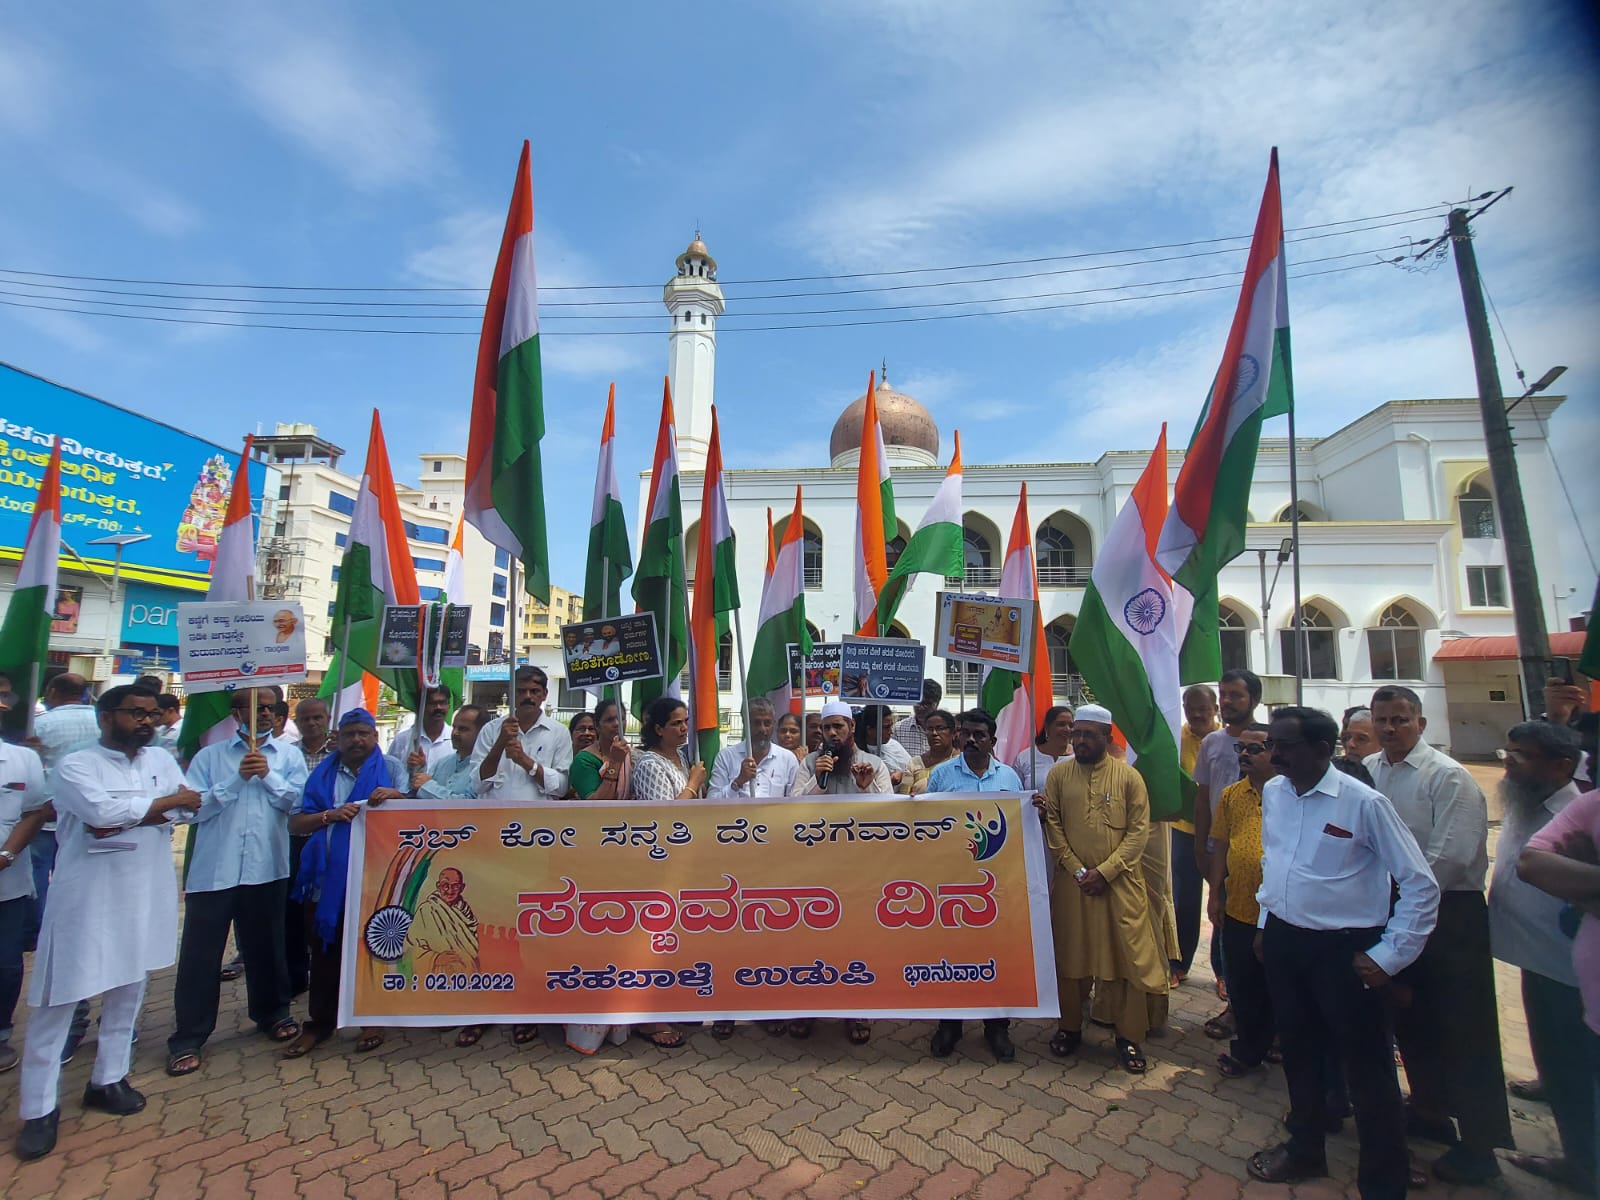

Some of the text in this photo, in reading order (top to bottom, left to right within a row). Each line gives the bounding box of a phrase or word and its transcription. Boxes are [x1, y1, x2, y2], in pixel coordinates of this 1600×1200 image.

[398, 816, 958, 861] ಸಬ್ ಕೋ ಸನ್ಮತಿ ದೇ ಭಗವಾನ್
[875, 868, 998, 929] ದಿನ
[382, 974, 406, 991] ತಾ
[425, 973, 515, 991] 02.10.2022
[545, 959, 876, 996] ಸಹಬಾಳ್ವೆ ಉಡುಪಿ
[903, 958, 996, 987] ಭಾನುವಾರ
